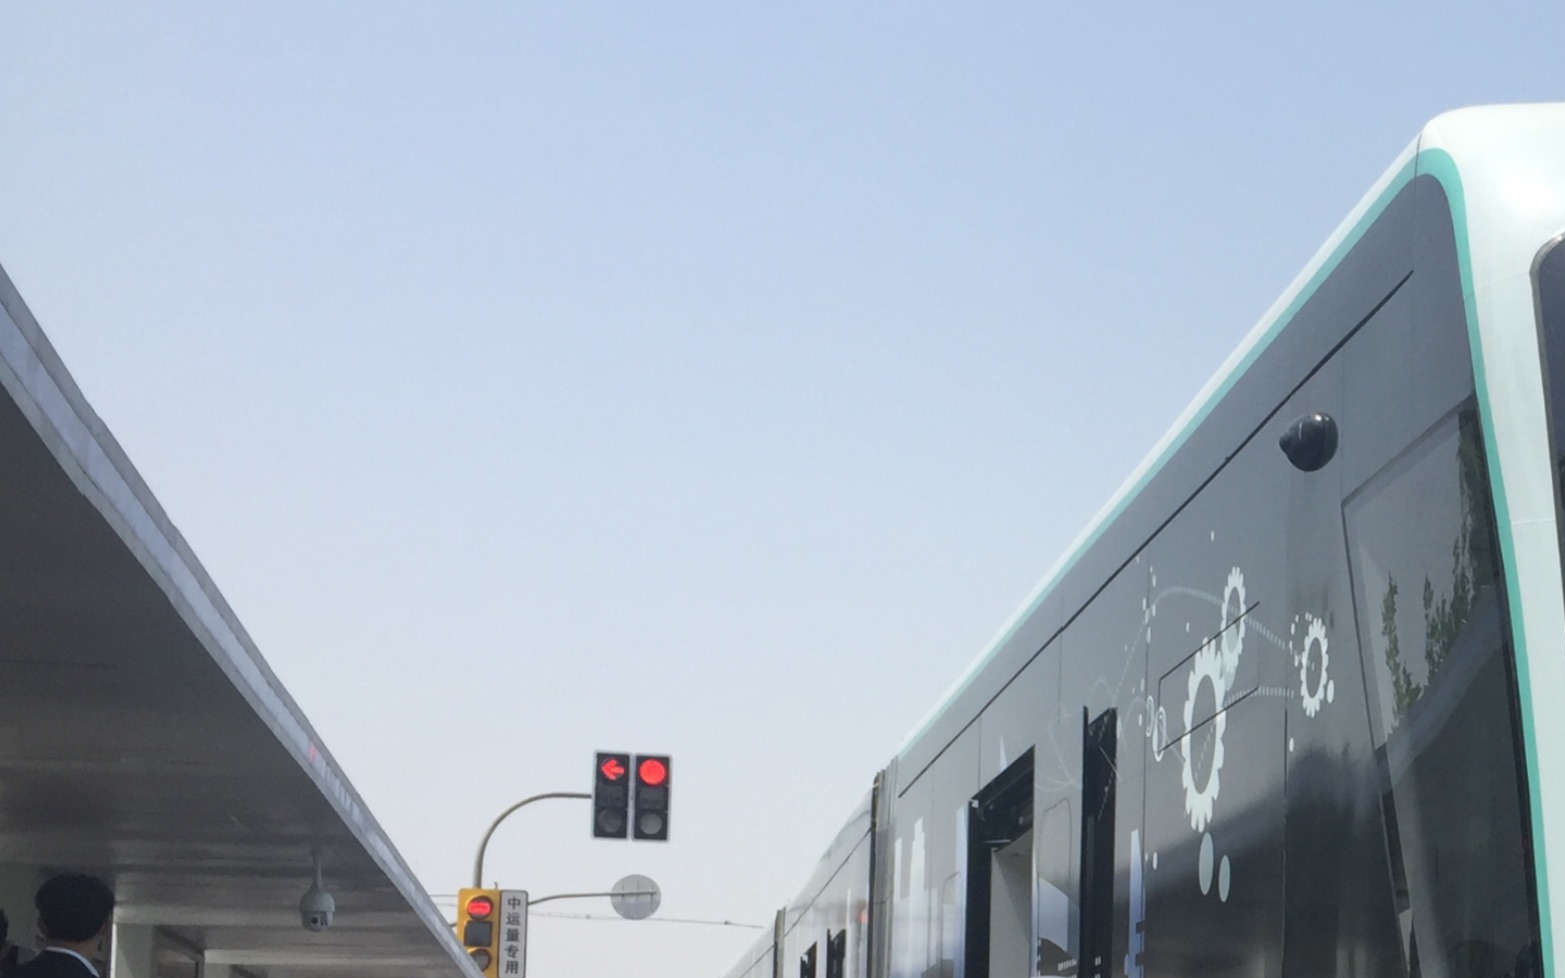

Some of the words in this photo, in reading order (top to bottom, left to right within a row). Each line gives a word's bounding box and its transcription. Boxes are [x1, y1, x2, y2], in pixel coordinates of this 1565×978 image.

[504, 895, 522, 975] 中运量专用
